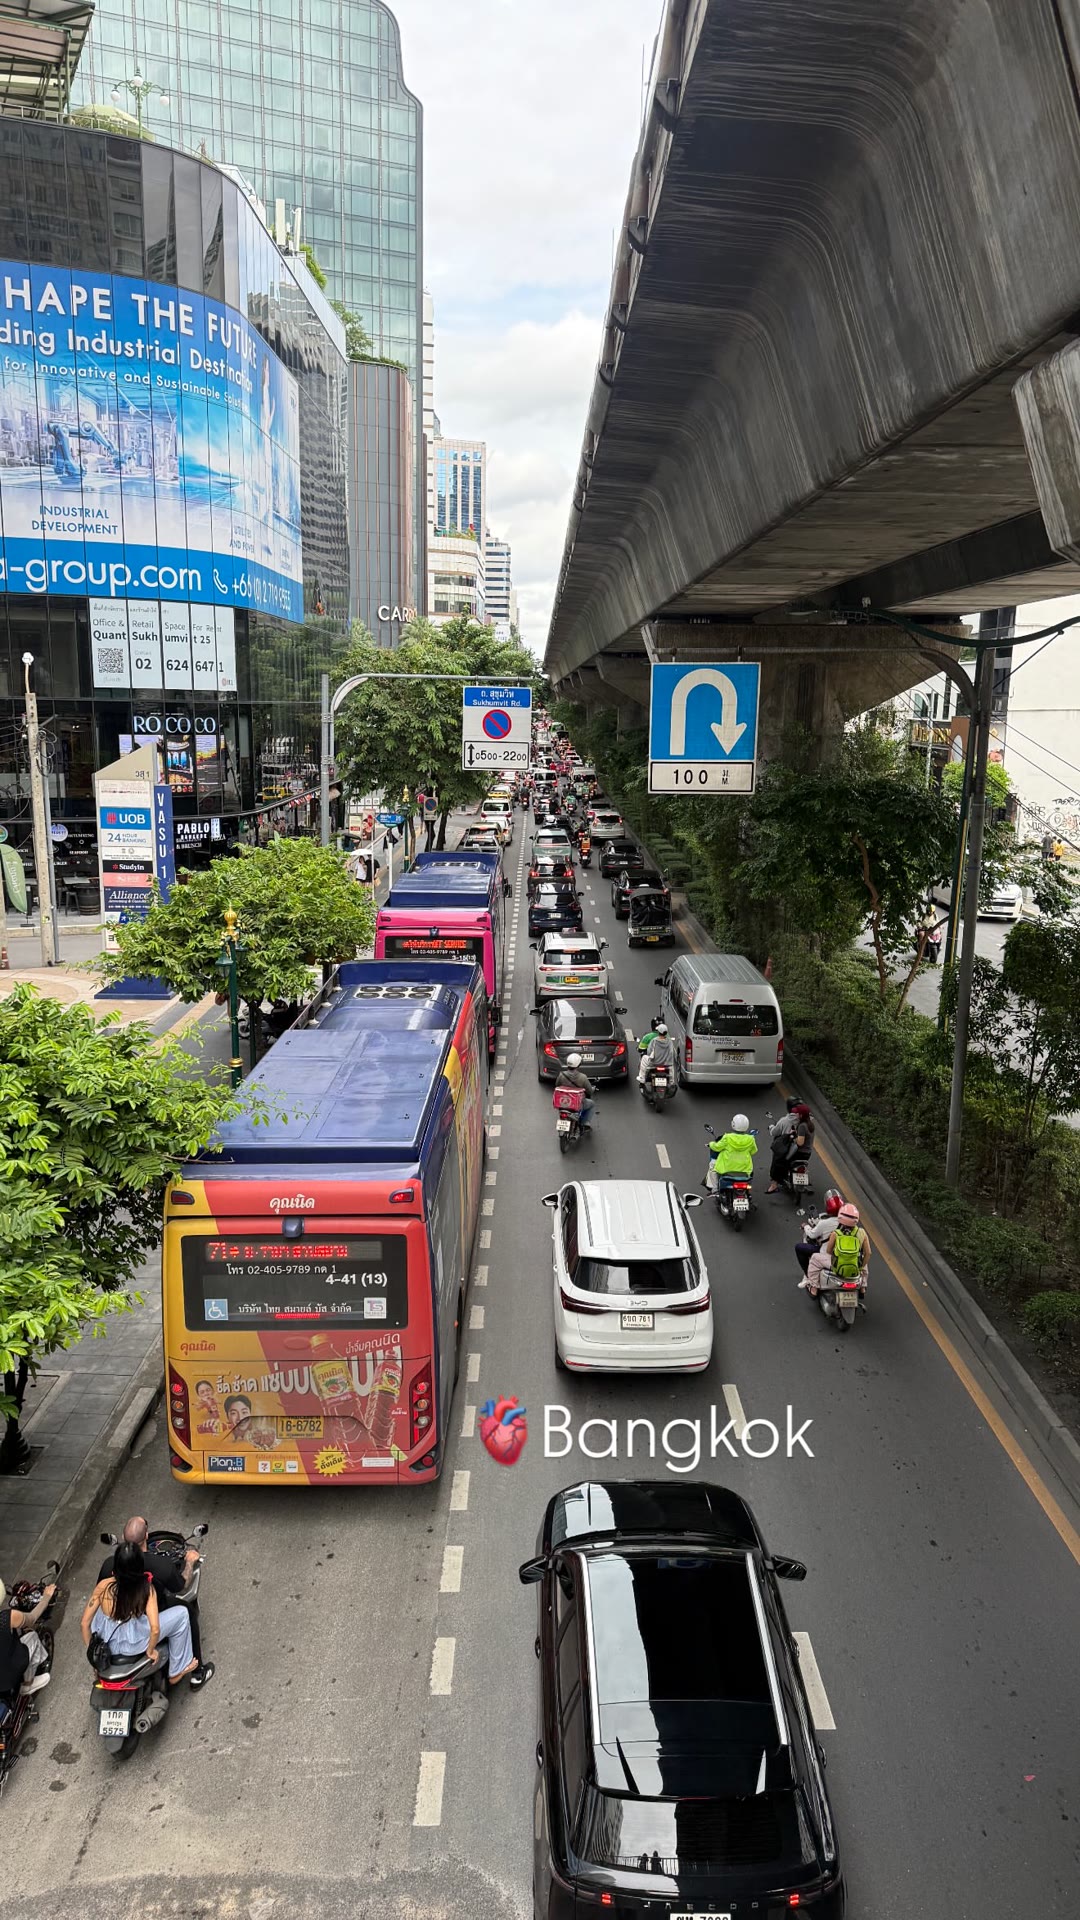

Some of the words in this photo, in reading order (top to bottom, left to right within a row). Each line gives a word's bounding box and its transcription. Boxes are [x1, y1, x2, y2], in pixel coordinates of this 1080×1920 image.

[131, 293, 194, 337] THE
[208, 312, 257, 370] FUTURE
[0, 319, 55, 356] ding
[67, 328, 180, 366] Industrial
[190, 347, 252, 394] Destination
[5, 356, 27, 371] for
[35, 360, 117, 380] Innovative
[124, 372, 150, 385] and
[156, 375, 221, 399] Sustainable
[39, 505, 110, 519] INDUSTRIAL
[31, 520, 119, 535] DEVELOPMENT
[232, 573, 252, 598] +66
[92, 618, 116, 628] Office
[132, 620, 154, 629] Retail
[164, 622, 186, 631] Space
[192, 624, 203, 632] For
[93, 630, 127, 641] Quant
[200, 636, 211, 644] 25
[135, 658, 152, 670] 02
[166, 660, 189, 671] 624
[472, 699, 508, 707] Sukhumvit
[133, 716, 216, 733] ROCOCO
[673, 769, 708, 785] 100
[119, 813, 146, 825] UOB
[157, 792, 167, 858] VASU
[177, 822, 210, 834] PABLO
[107, 832, 122, 843] 24
[161, 865, 167, 879] 1
[270, 1193, 315, 1215] คุณนิด
[226, 1263, 244, 1275] โทร
[247, 1265, 311, 1275] 02-405-9789
[314, 1265, 328, 1274] กด
[331, 1264, 337, 1274] 1
[325, 1273, 357, 1285] 4-41
[361, 1272, 388, 1288] (13)
[238, 1303, 262, 1313] บริษัท
[264, 1302, 281, 1313] ไทย
[284, 1303, 311, 1313] สมายล์
[330, 1302, 352, 1313] จำกัด
[639, 1315, 651, 1323] 761
[180, 1340, 216, 1356] คุณนิด
[281, 1420, 322, 1433] 16-6782
[102, 1727, 124, 1736] 5575
